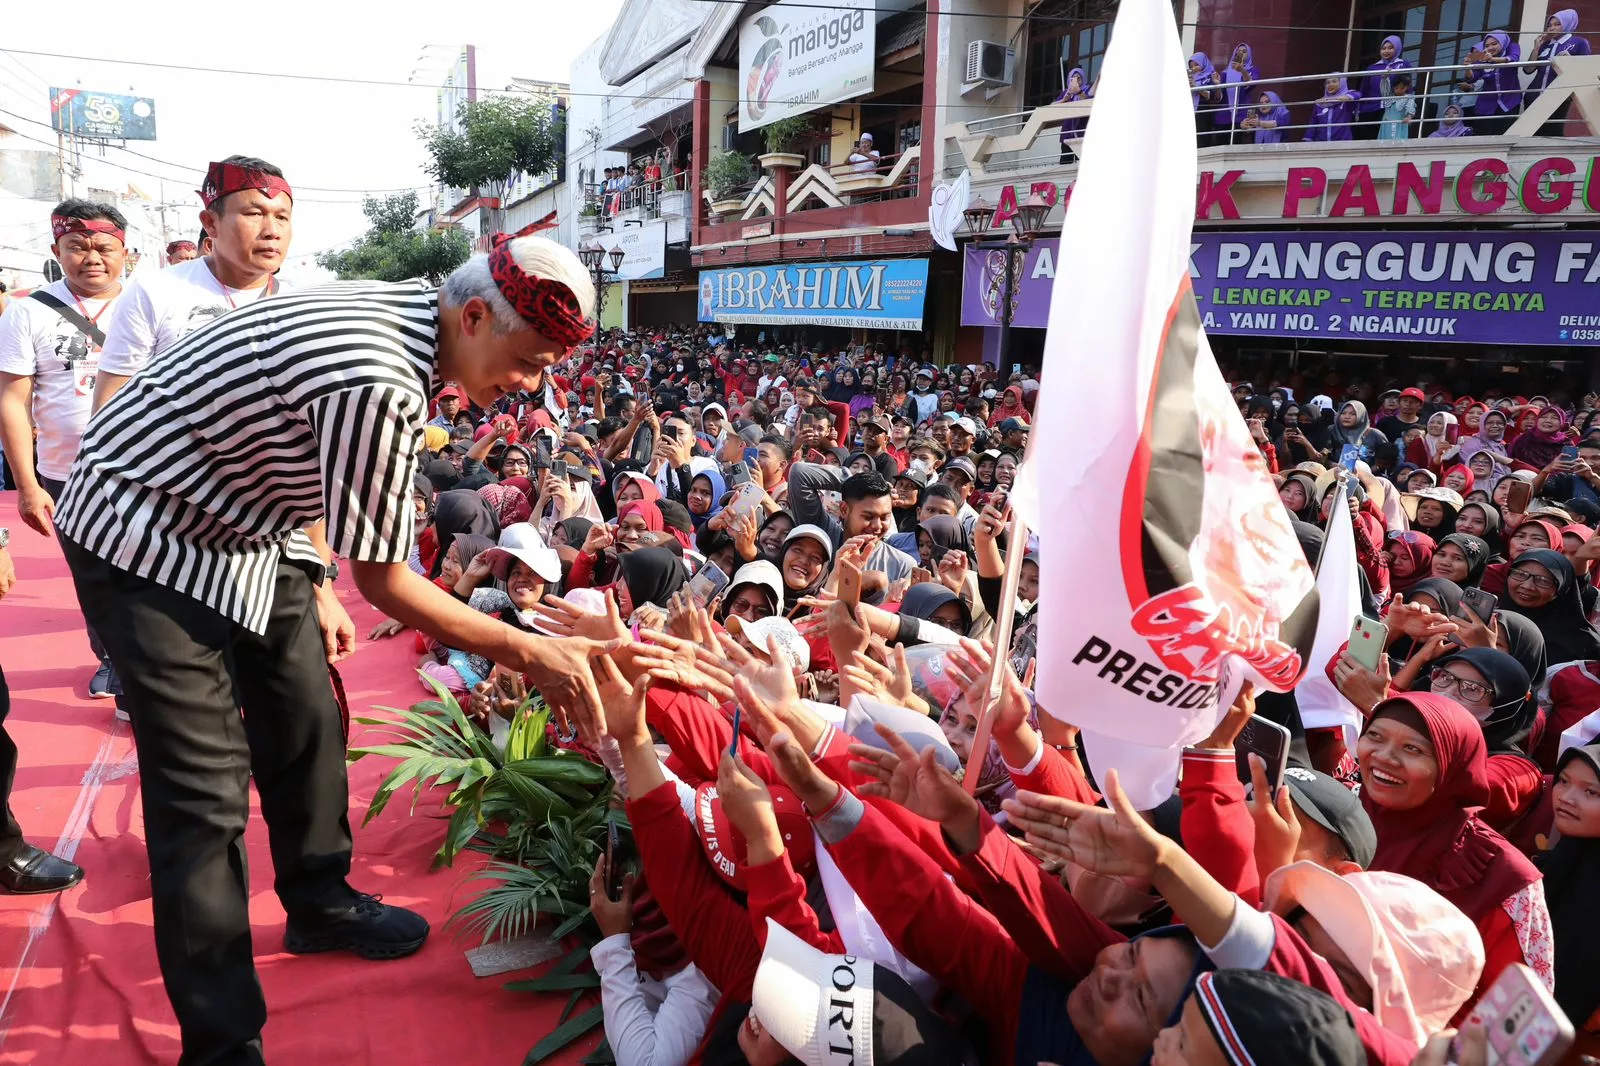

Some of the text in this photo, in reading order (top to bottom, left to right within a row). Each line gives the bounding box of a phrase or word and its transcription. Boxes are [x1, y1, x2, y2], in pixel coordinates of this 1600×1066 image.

[788, 9, 864, 59] mangga
[788, 42, 863, 77] Bangga Bersarung Mangga
[1281, 157, 1600, 217] PANGG
[622, 234, 639, 244] APOTEK
[1216, 241, 1536, 284] PANGGUNG
[717, 265, 887, 311] IBRAHIM
[1212, 287, 1332, 307] LENGKAP
[1362, 290, 1545, 312] TERPERCAYA
[855, 319, 892, 329] SERAGAM
[893, 321, 899, 329] &
[900, 320, 918, 330] ATK
[1230, 312, 1278, 329] YANI
[1283, 314, 1320, 332] NO.
[1328, 314, 1342, 332] 2
[1349, 315, 1457, 336] NGANJUK
[706, 837, 718, 850] IS
[713, 850, 736, 878] DEAD
